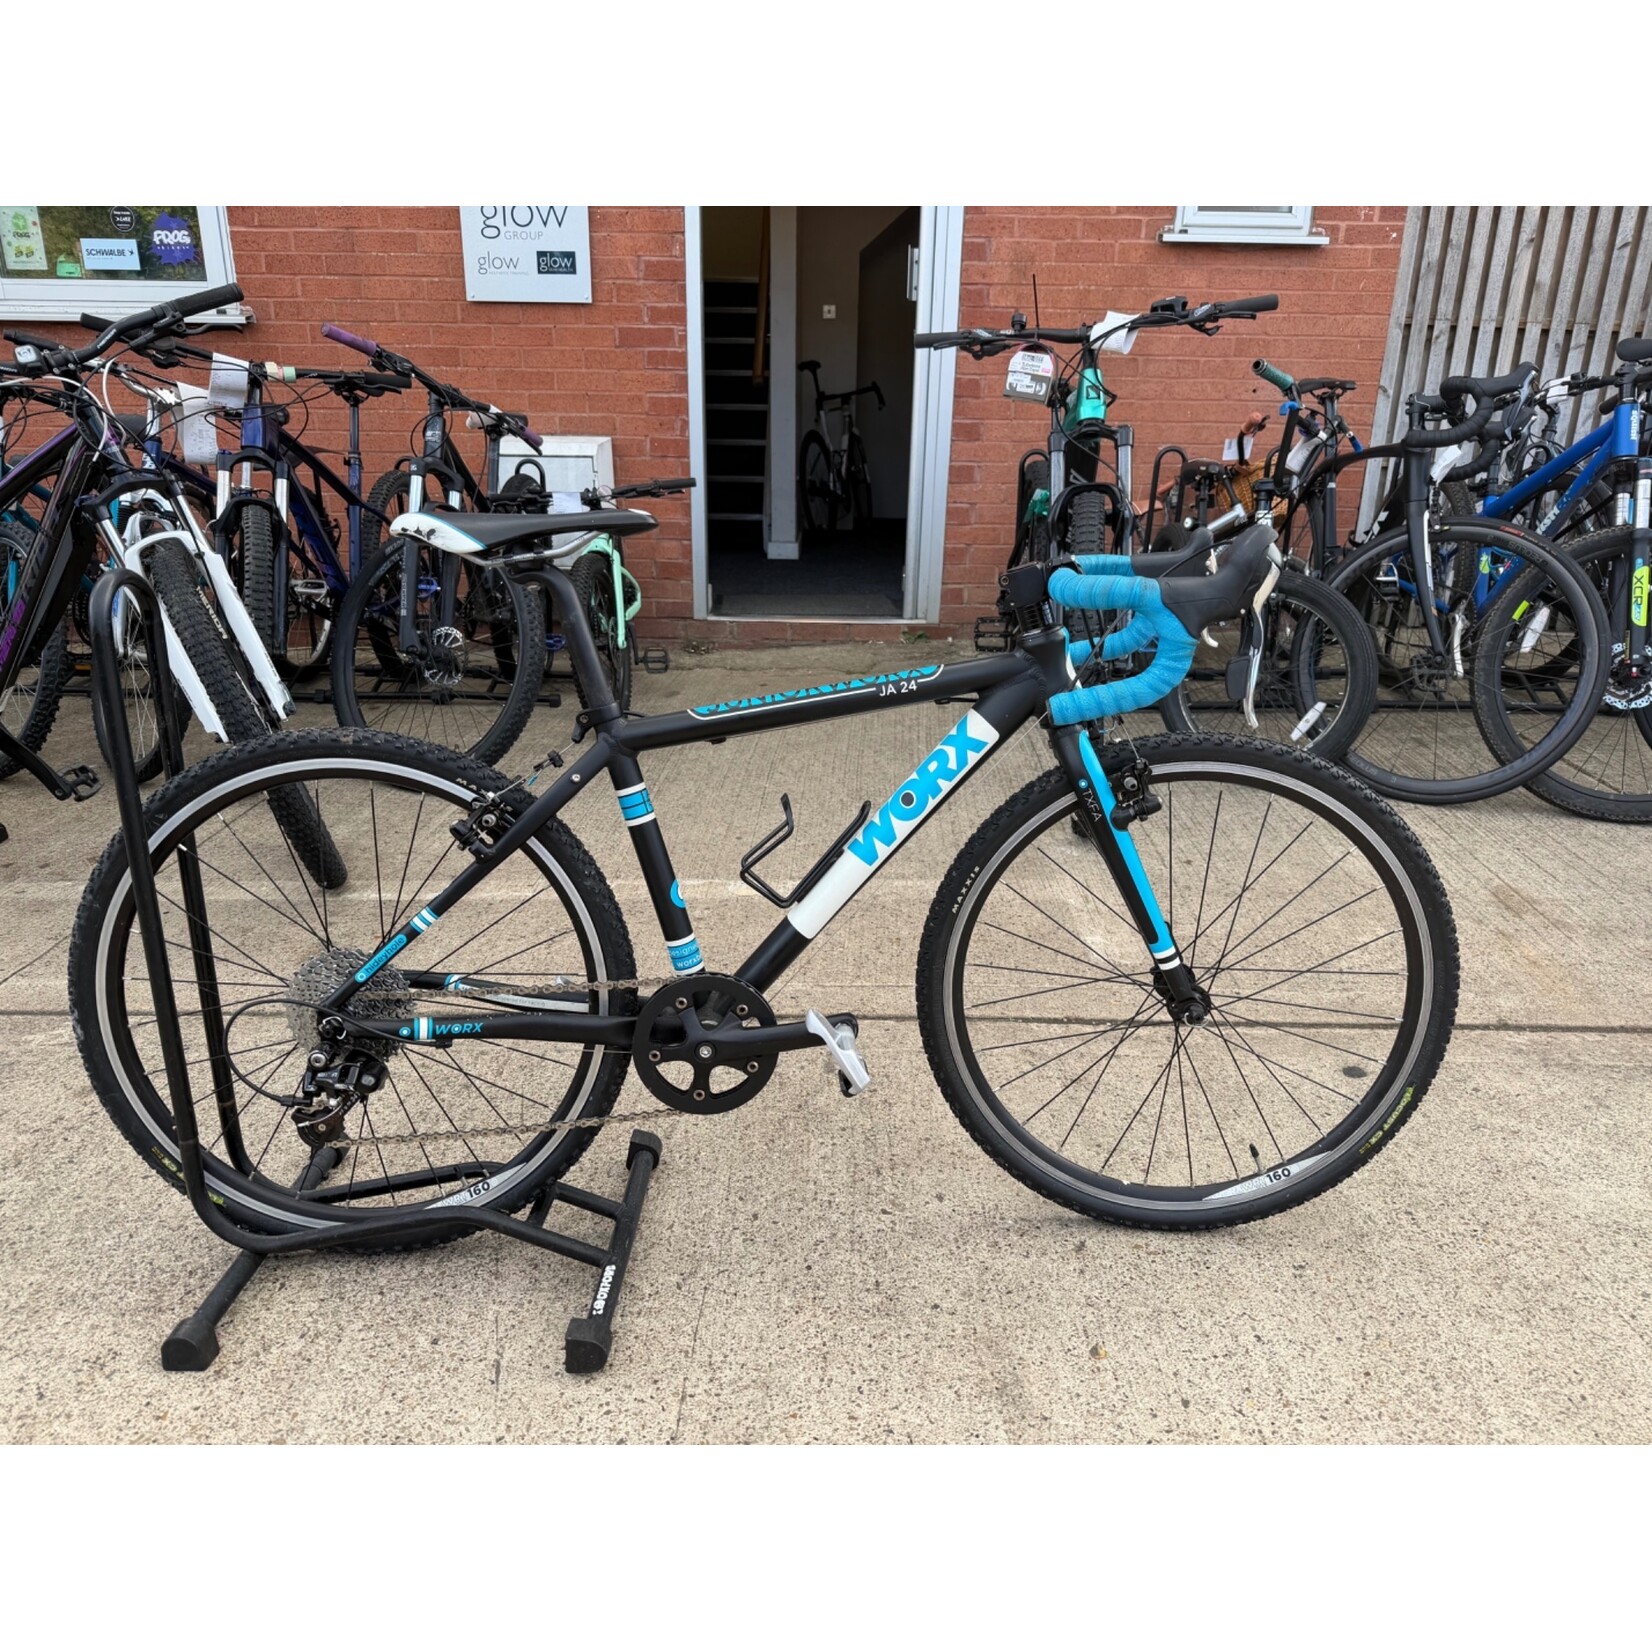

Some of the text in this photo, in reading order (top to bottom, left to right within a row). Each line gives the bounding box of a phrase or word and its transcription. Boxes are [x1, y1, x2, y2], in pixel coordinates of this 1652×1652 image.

[480, 206, 568, 240] glow
[152, 229, 192, 245] FROG
[503, 230, 543, 240] GROUP
[85, 248, 127, 257] SCHWALBE
[477, 251, 520, 275] glow
[539, 253, 573, 272] glow
[1632, 574, 1645, 606] XCR
[879, 682, 898, 697] JA
[899, 679, 918, 694] 24
[847, 713, 990, 867] WORX
[951, 865, 981, 914] MAXXIS
[364, 936, 406, 975] hideyhole
[435, 1022, 484, 1036] WORX
[1266, 1167, 1292, 1183] 160
[466, 1180, 491, 1199] 160
